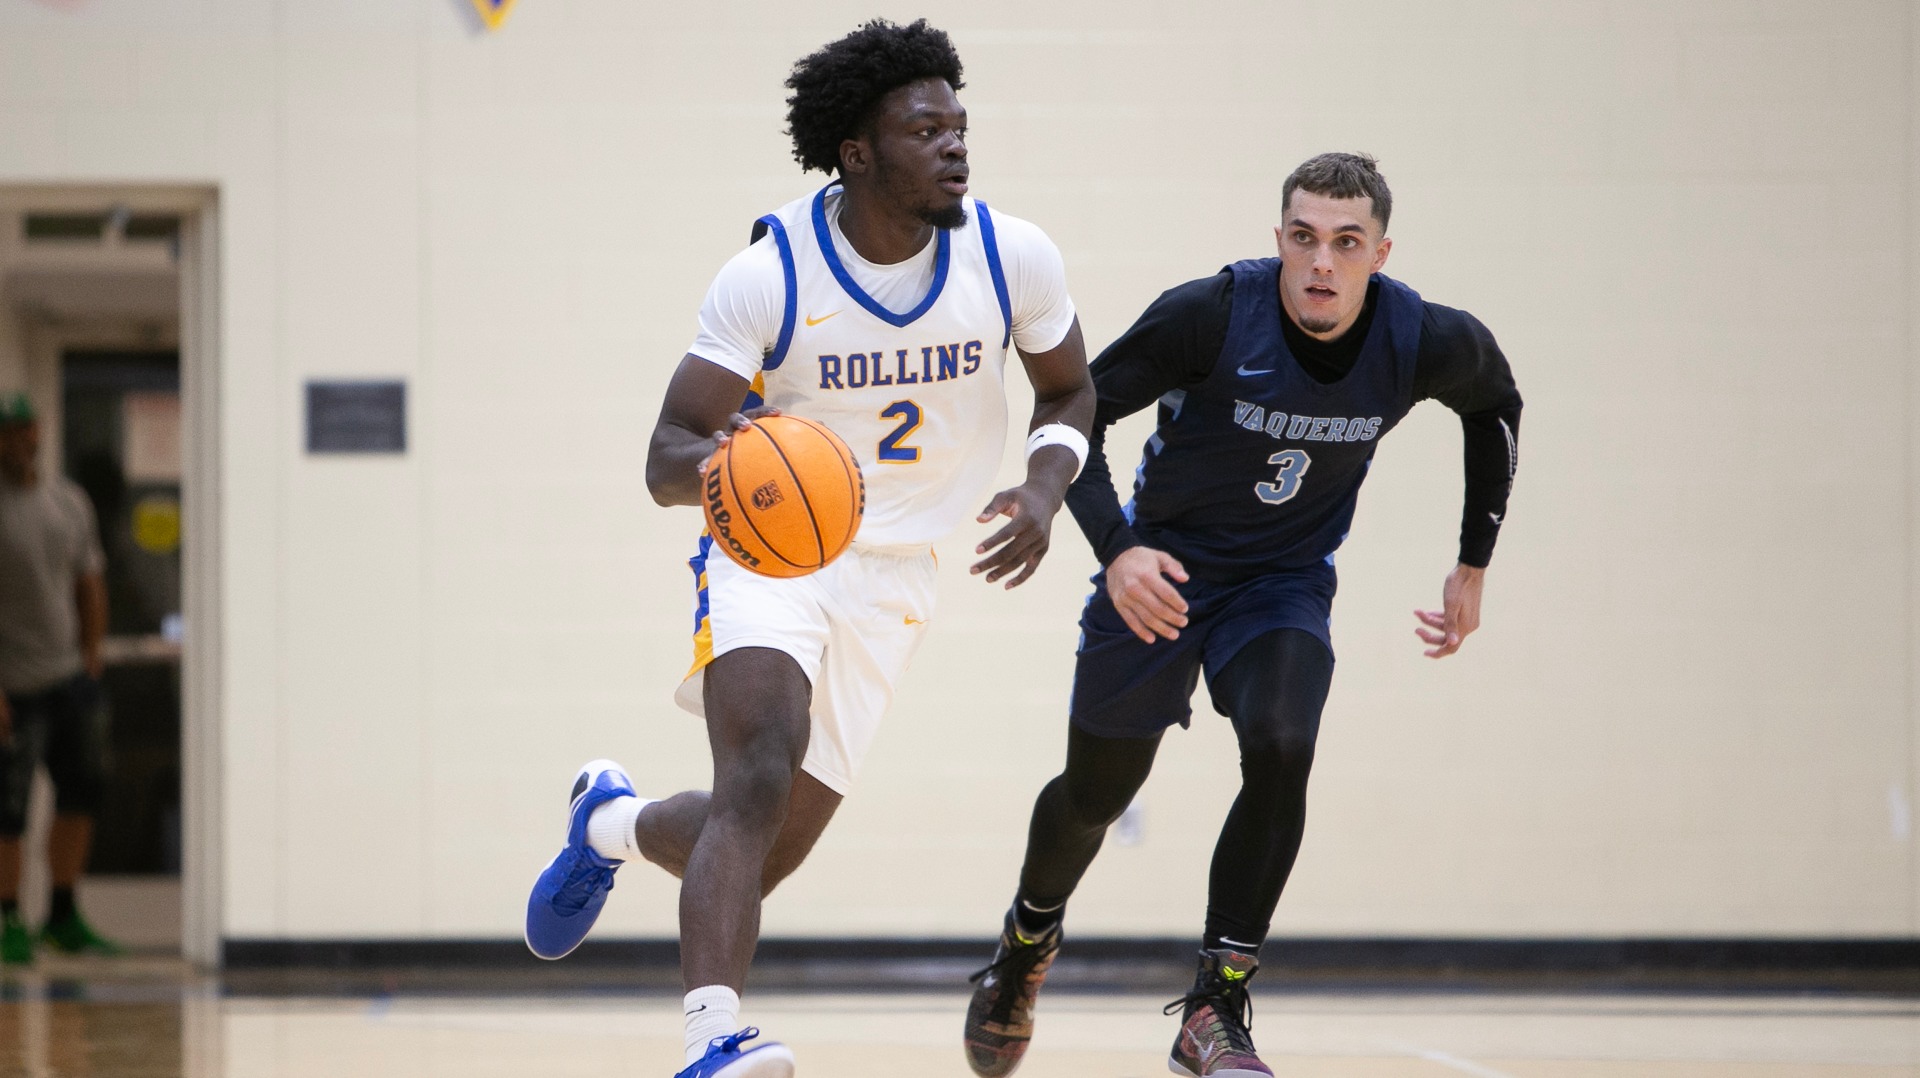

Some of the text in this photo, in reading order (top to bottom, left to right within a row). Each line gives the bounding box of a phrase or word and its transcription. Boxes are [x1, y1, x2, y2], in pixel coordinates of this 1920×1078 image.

[818, 339, 983, 390] ROLLINS
[876, 399, 924, 464] 2
[1234, 399, 1382, 442] VAQUEROS
[1254, 449, 1312, 505] 3
[707, 464, 761, 567] Wilson
